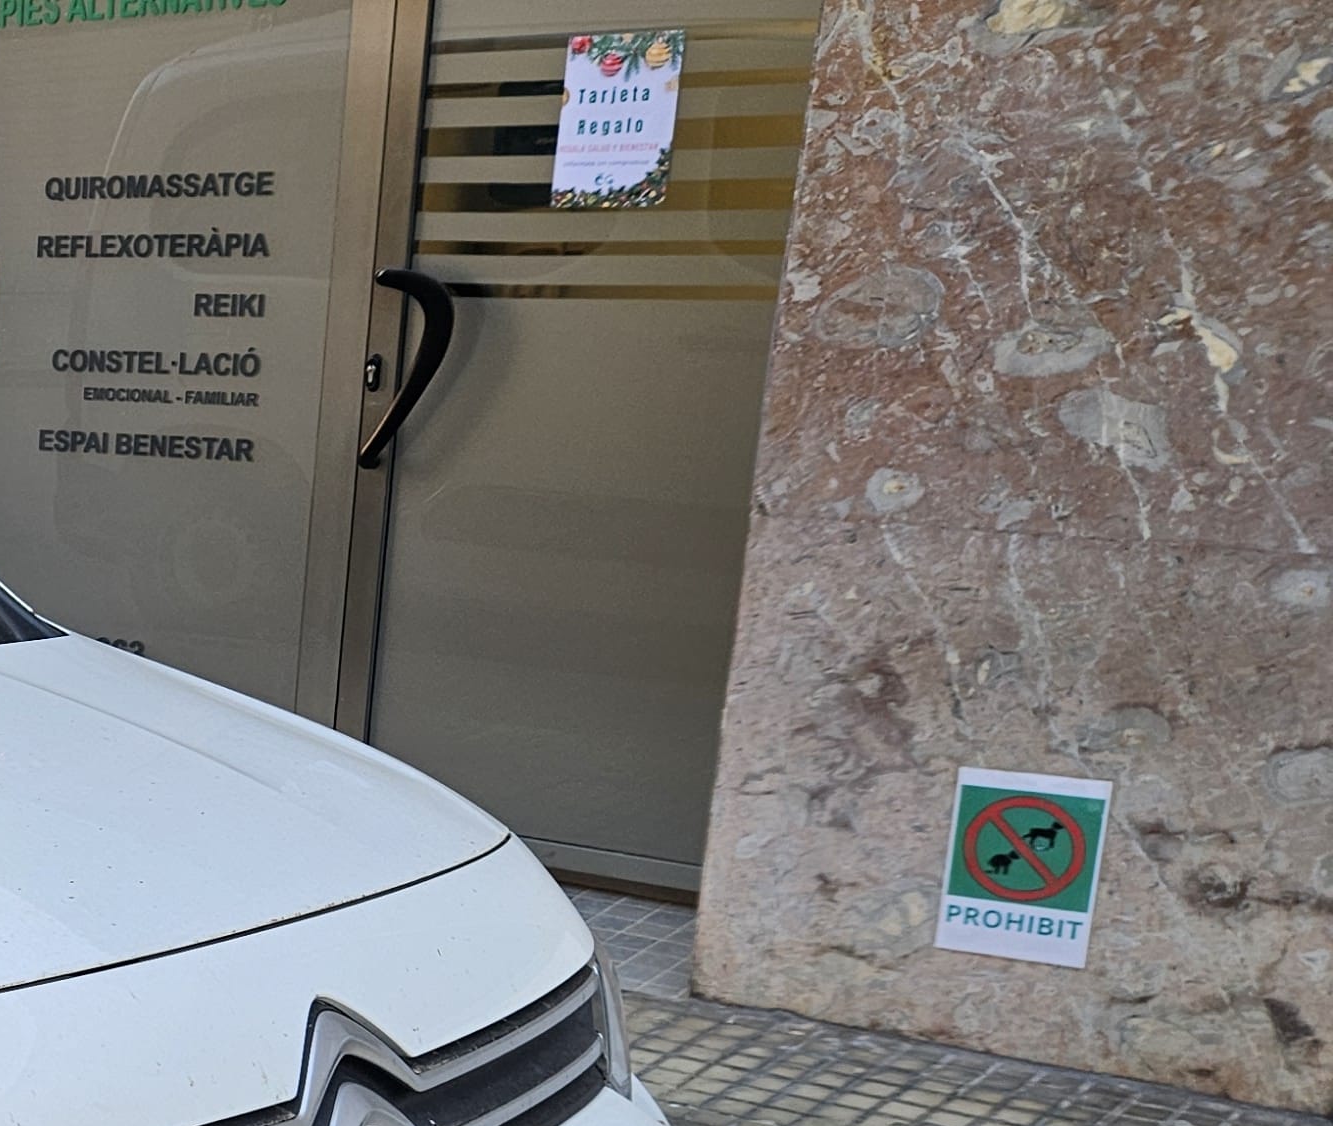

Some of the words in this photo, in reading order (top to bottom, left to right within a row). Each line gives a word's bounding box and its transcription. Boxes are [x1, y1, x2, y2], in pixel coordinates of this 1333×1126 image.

[578, 85, 650, 105] Tarjeta
[577, 117, 644, 136] Regalo
[44, 171, 275, 201] QUIROMASSATGE
[36, 227, 270, 259] REFLEXOTERÀPIA
[193, 293, 266, 318] REIKI
[51, 346, 261, 378] CONSTEL·LACIÓ
[82, 386, 173, 404] EMOCIONAL
[184, 390, 260, 407] FAMILIAR
[38, 429, 109, 454] ESPAI
[114, 432, 255, 462] BENESTAR
[945, 903, 1085, 941] PROHIBIT
